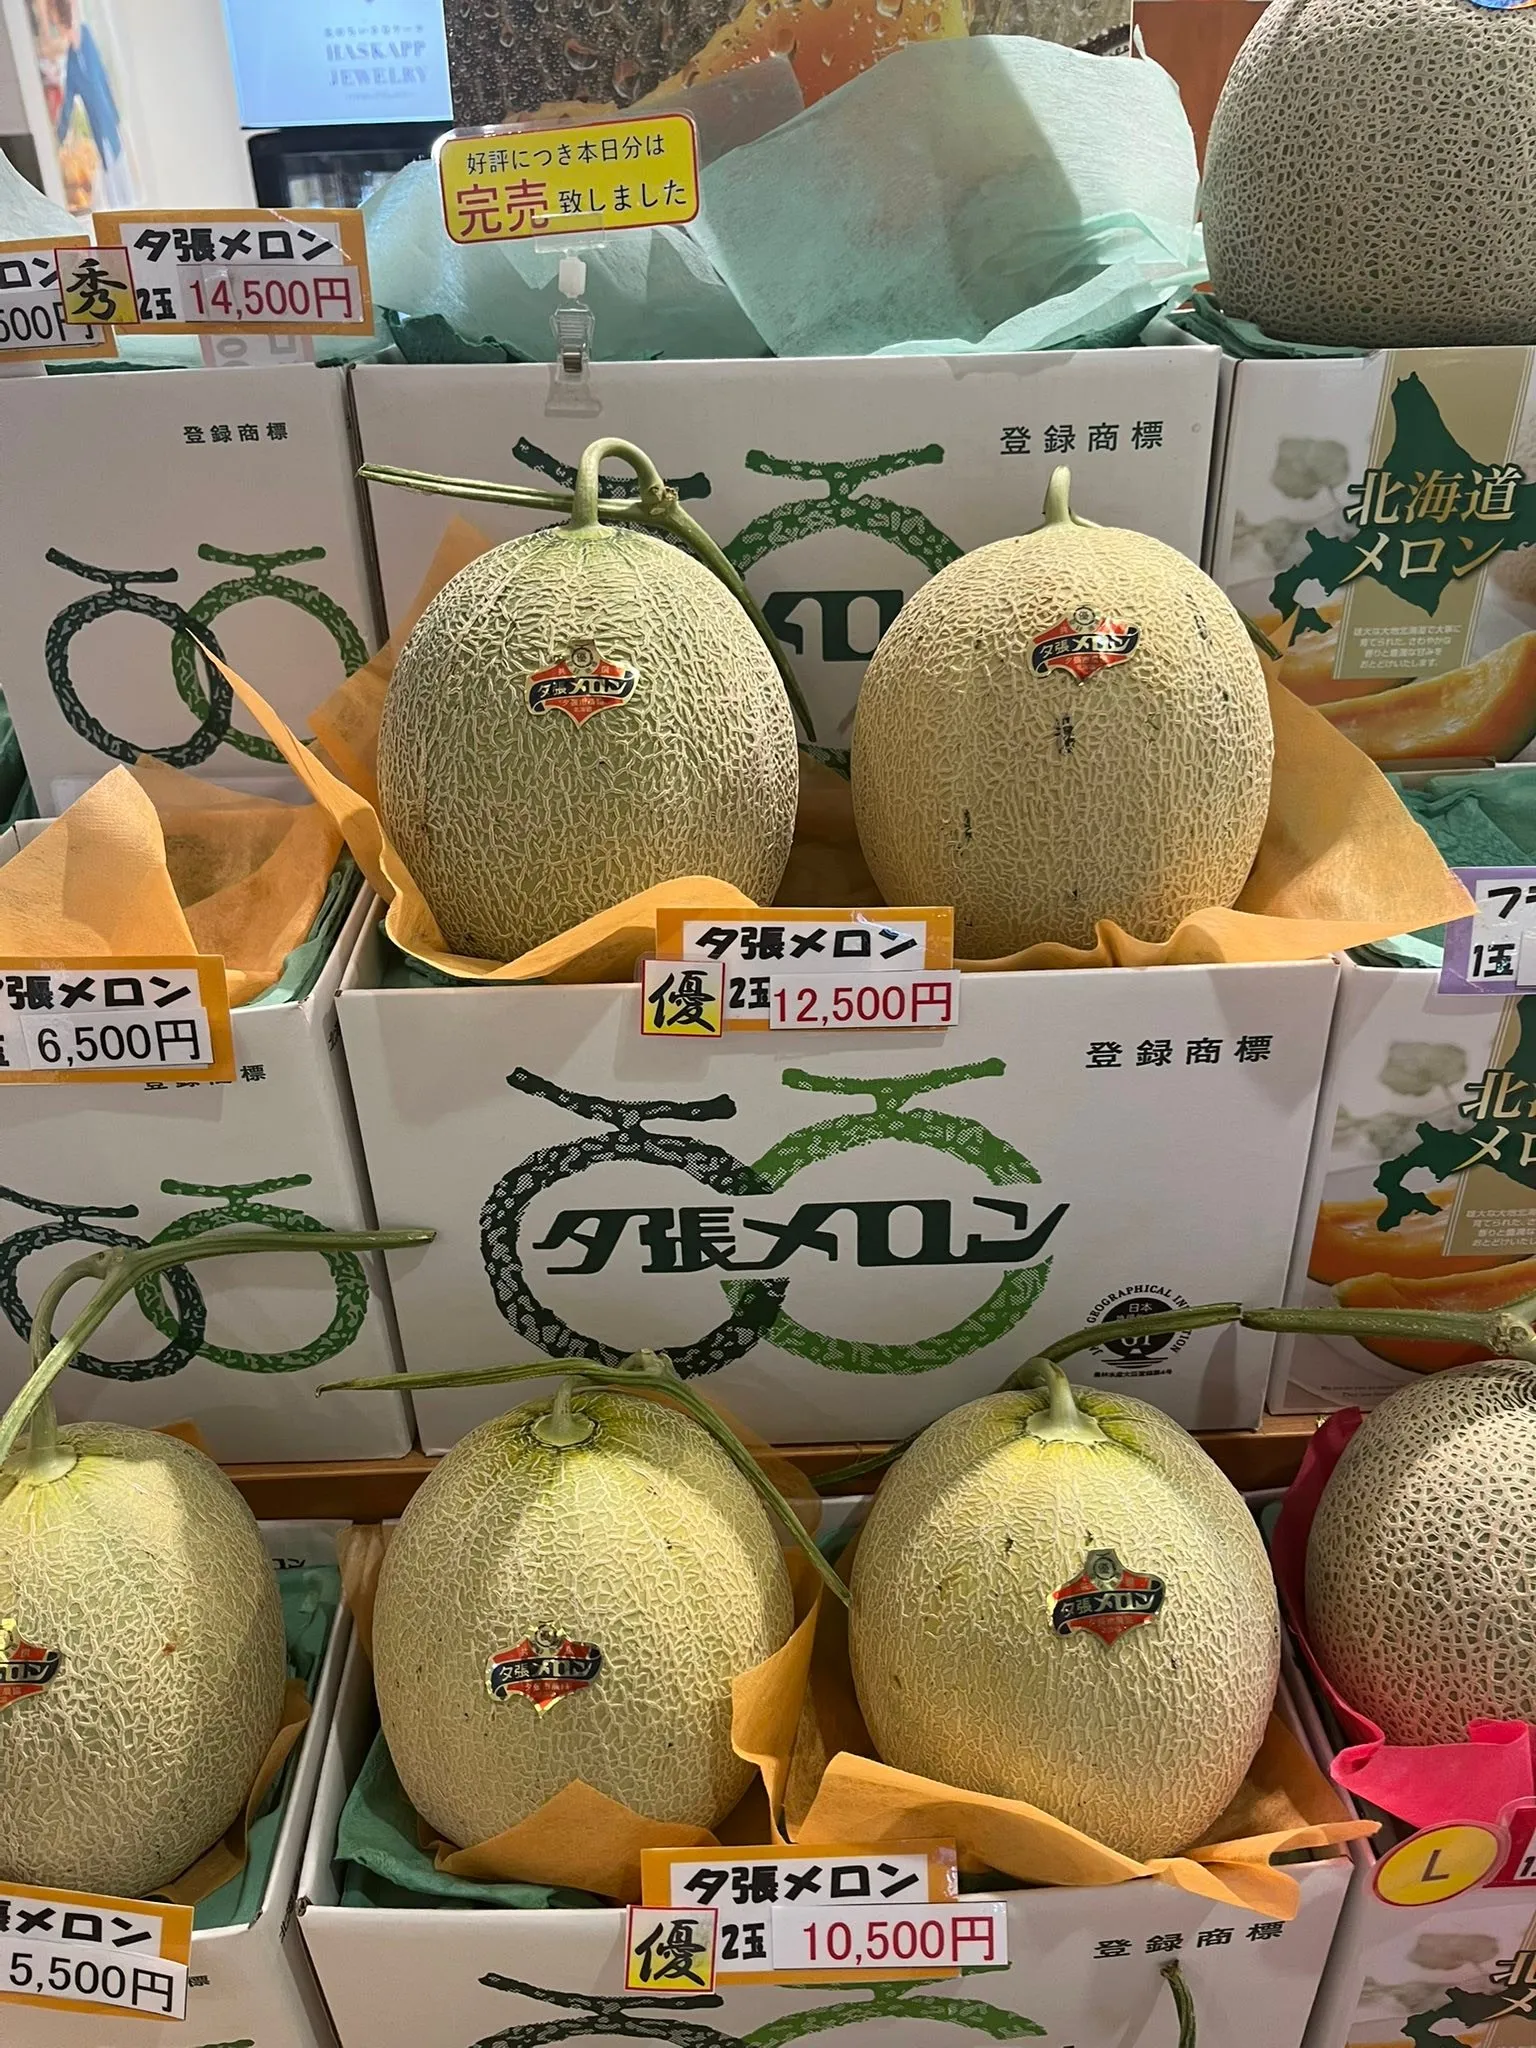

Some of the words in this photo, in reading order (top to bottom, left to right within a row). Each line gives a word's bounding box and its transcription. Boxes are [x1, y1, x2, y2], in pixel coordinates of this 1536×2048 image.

[329, 66, 428, 85] JEWELRY
[467, 134, 665, 175] 好評につき本日分は
[134, 228, 333, 262] 夕張メロン
[66, 258, 127, 320] 秀
[136, 288, 177, 319] 2玉
[190, 278, 352, 320] 14,500円
[183, 422, 288, 444] 登録商標
[1000, 421, 1163, 455] 登録商標
[1346, 466, 1522, 526] 北海道
[1339, 532, 1504, 583] メロン
[1040, 634, 1130, 658] 夕張メロン
[537, 679, 627, 698] 夕張メロン
[695, 926, 917, 960] 夕張メロン
[1473, 943, 1515, 977] 1玉
[0, 975, 191, 1009] 張メロン
[648, 969, 716, 1032] 優
[729, 976, 770, 1009] 2玉
[773, 982, 951, 1026] 12,500円
[37, 1019, 200, 1067] 6,500円
[1085, 1035, 1273, 1069] 登録商標
[533, 1196, 1070, 1275] 夕張メロン
[1086, 1285, 1172, 1324] GEOGRAPHICAL
[1129, 1303, 1152, 1313] 日本
[1060, 1592, 1155, 1618] 夕張メロン
[500, 1659, 592, 1681] 夕張メロン
[684, 1863, 919, 1905] 夕張メロン
[1421, 1849, 1449, 1882] L
[635, 1919, 706, 1987] 優
[721, 1922, 767, 1960] 2玉
[803, 1916, 995, 1965] 10,500円
[1093, 1921, 1285, 1958] 登録商標
[9, 1952, 173, 2012] 5,500円
